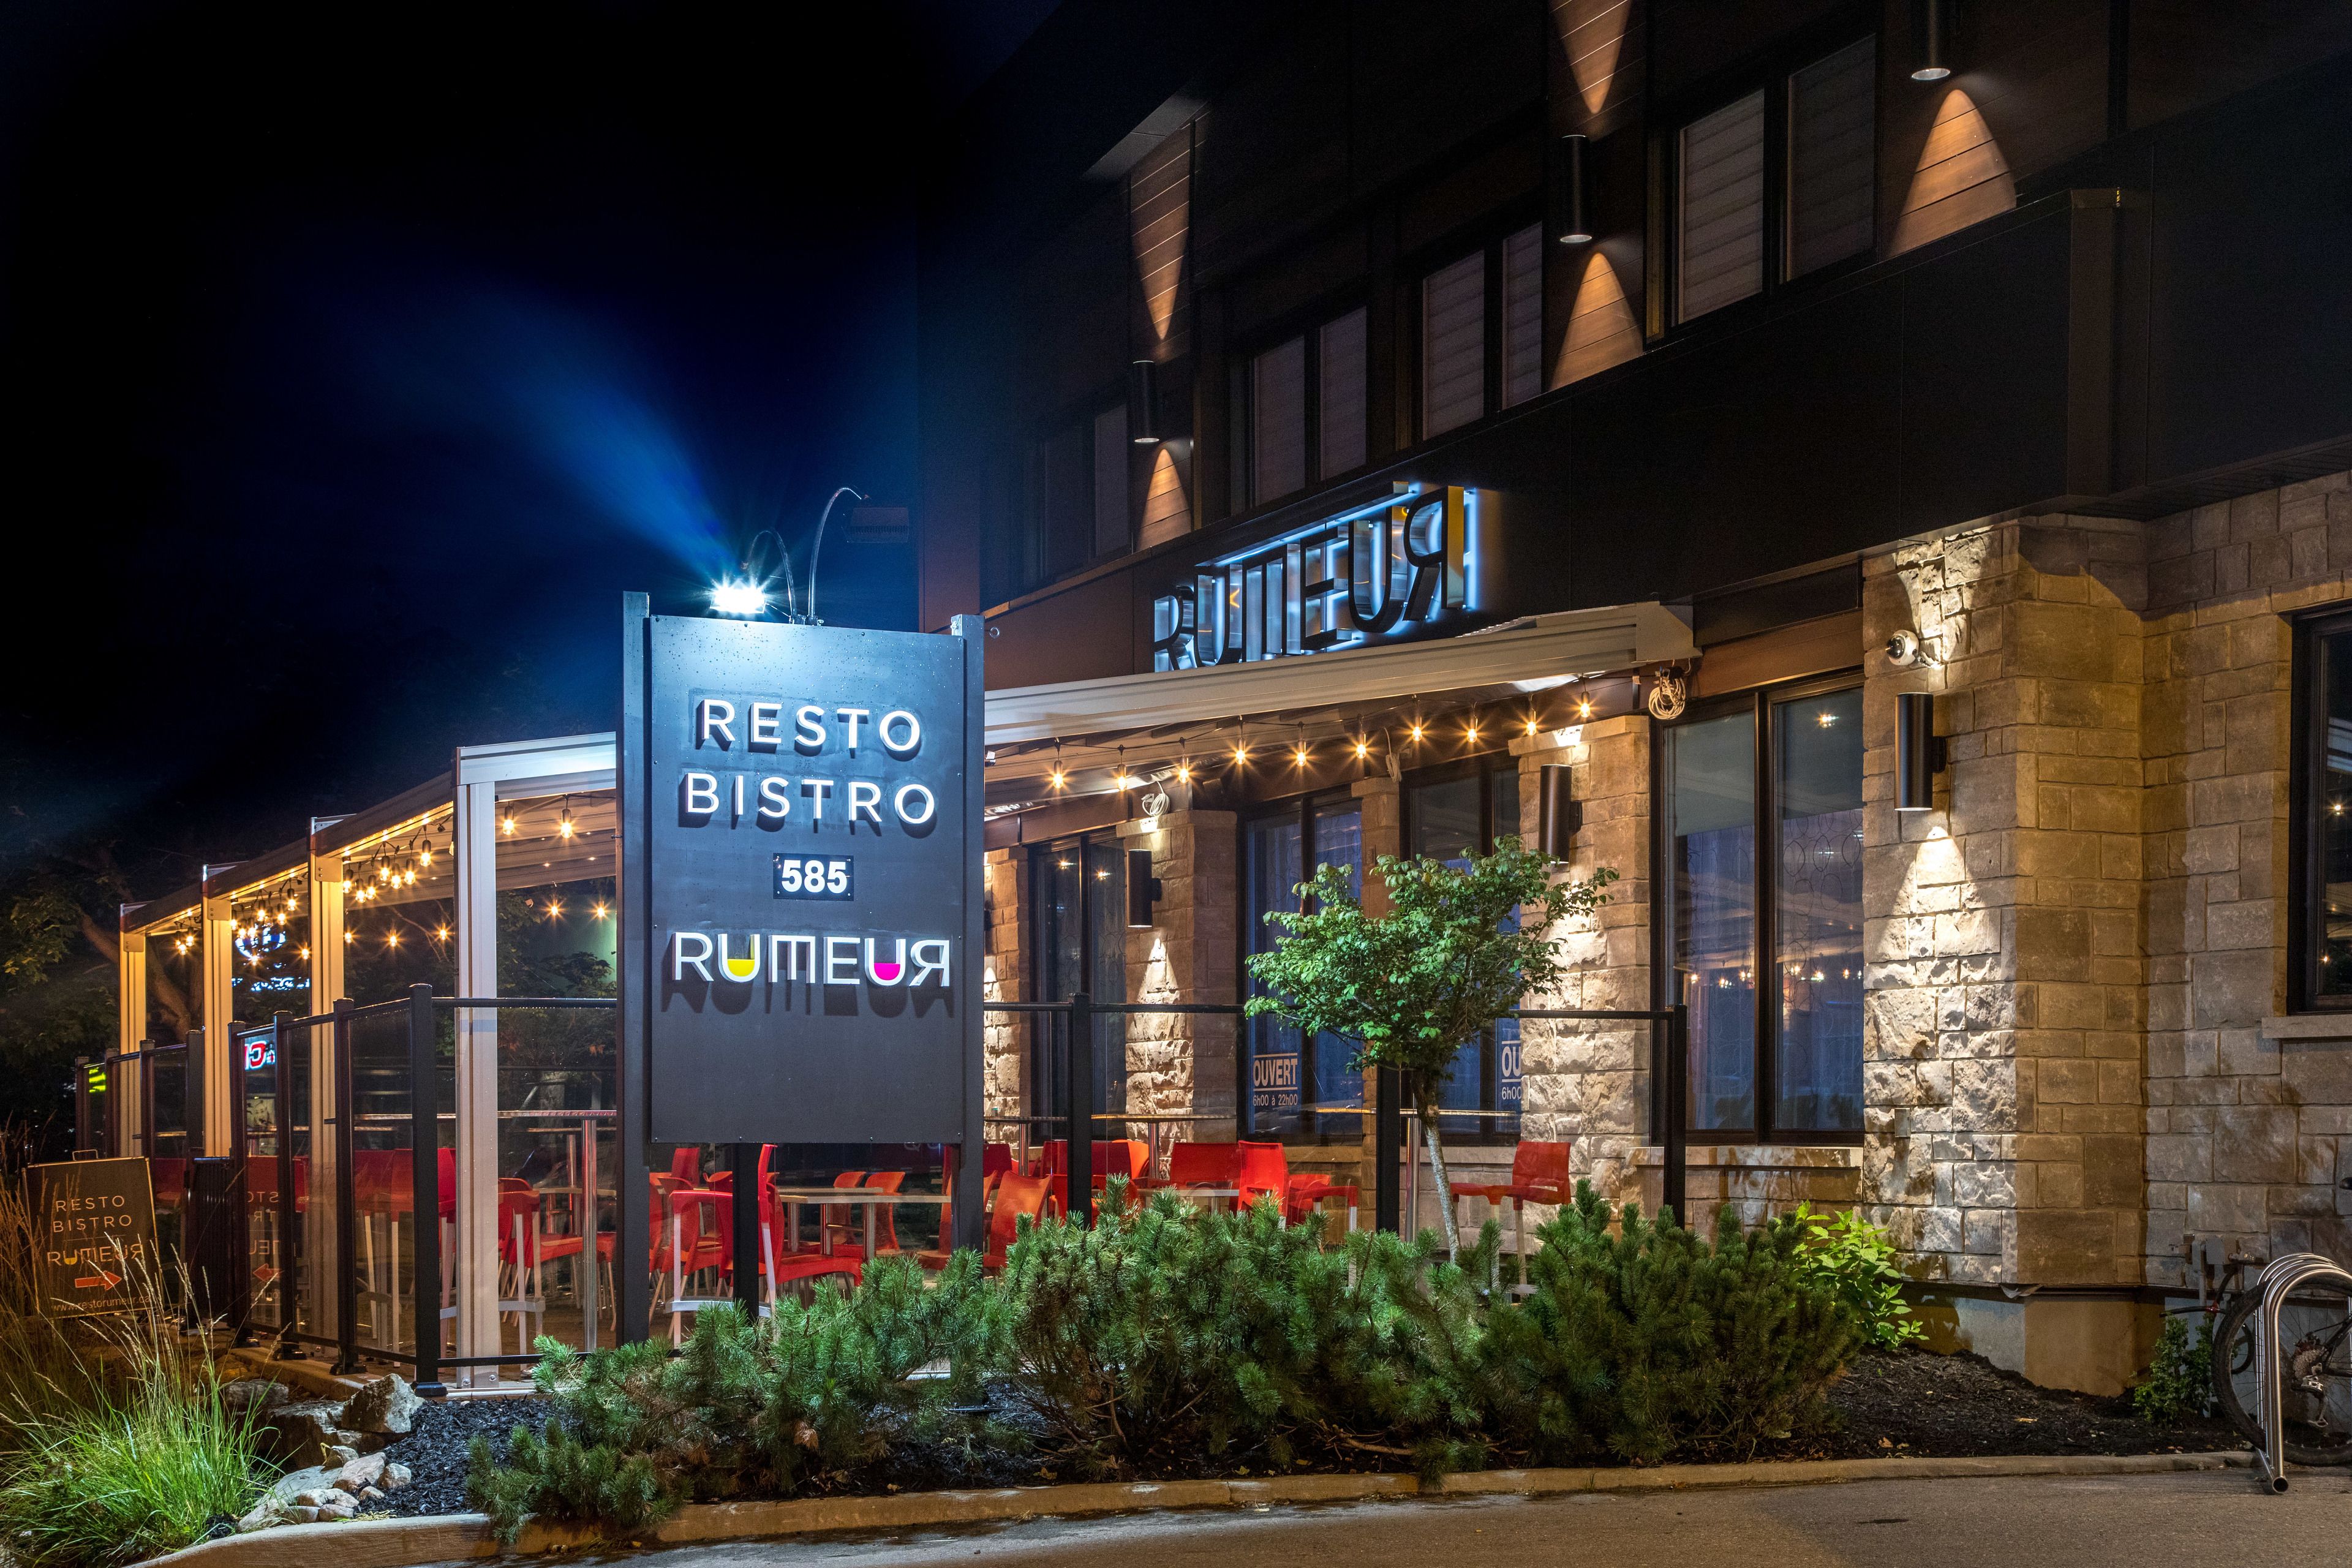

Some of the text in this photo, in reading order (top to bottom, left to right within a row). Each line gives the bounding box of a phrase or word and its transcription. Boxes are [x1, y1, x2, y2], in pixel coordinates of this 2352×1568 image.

[701, 699, 920, 752] RESTO
[685, 772, 935, 824] BISTRO
[781, 859, 848, 894] 585
[1253, 1058, 1298, 1087] OUVERT
[1253, 1093, 1298, 1107] 6h00 à 22h00
[56, 1195, 125, 1212] RESTO
[53, 1215, 132, 1233] BISTRO
